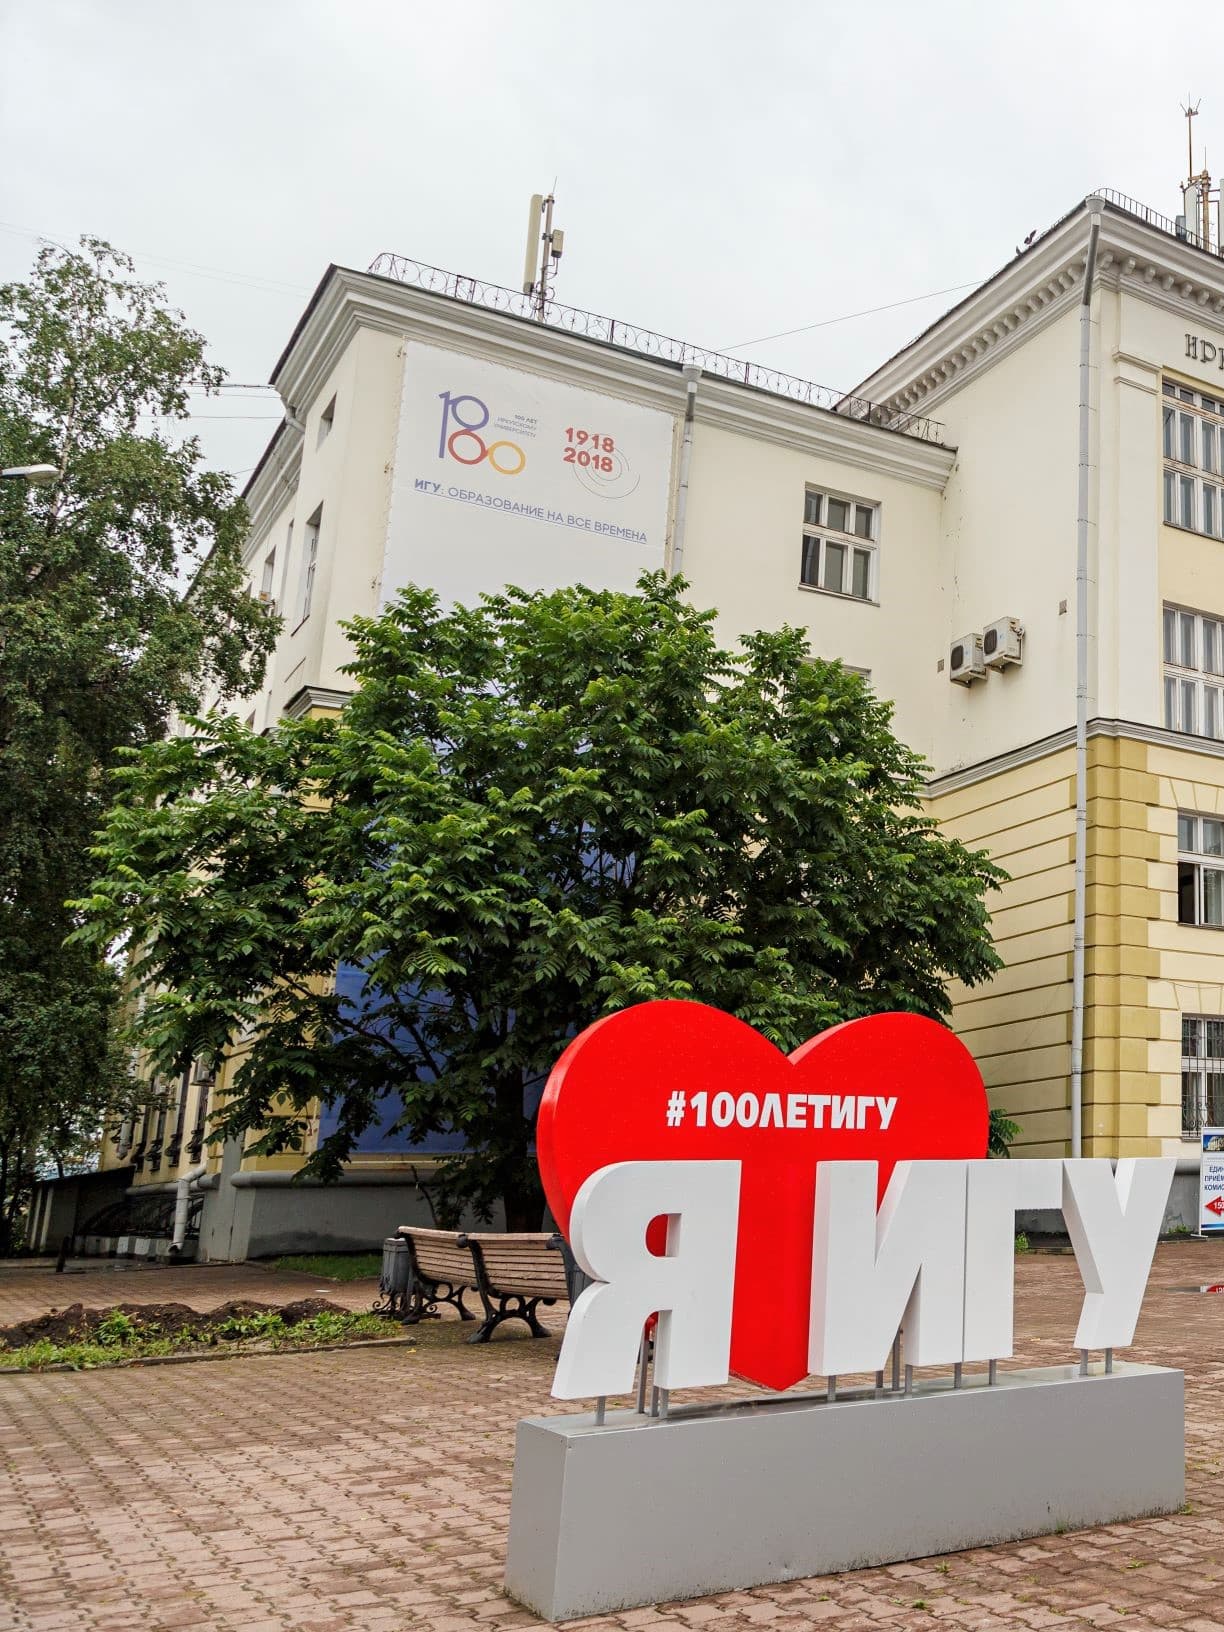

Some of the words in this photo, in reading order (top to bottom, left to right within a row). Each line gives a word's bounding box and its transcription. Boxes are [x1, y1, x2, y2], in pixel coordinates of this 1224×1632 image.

[564, 427, 615, 454] 1918
[563, 447, 613, 473] 2018
[448, 487, 544, 518] ОБРАЗОВАНИЕ
[547, 509, 564, 522] НА
[567, 515, 591, 529] ВСЕ
[594, 521, 648, 542] ВРЕМЕНА
[666, 1090, 898, 1130] #100ЛЕТИГУ
[1213, 1201, 1224, 1209] 150
[551, 1160, 742, 1399] Я
[808, 1159, 1177, 1375] ИГУ
